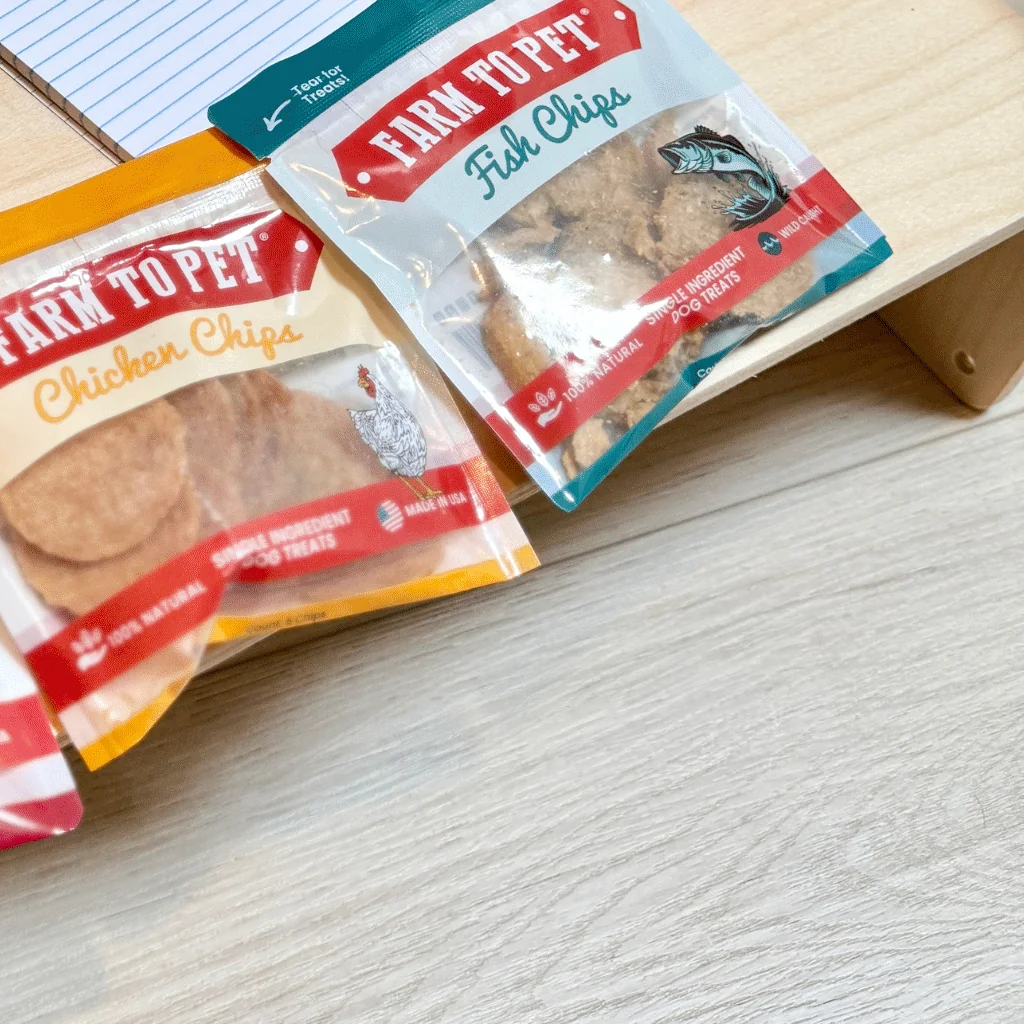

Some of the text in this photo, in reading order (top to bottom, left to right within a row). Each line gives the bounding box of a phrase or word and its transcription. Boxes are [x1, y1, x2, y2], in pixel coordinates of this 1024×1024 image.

[290, 65, 342, 95] Tear for
[301, 73, 350, 104] Treats!
[368, 81, 485, 169] FARM
[461, 50, 531, 97] TO
[464, 87, 632, 201] Fish Chips
[778, 220, 801, 239] WILD
[108, 256, 176, 310] TO
[645, 245, 746, 325] SINGLE INGREDIENT
[671, 270, 741, 325] DOG TREATS
[34, 313, 304, 423] Chicken Chips
[562, 337, 644, 403] 100% NATURAL
[268, 508, 352, 544] INGREDIENT
[405, 492, 467, 516] MADE IN USA
[282, 532, 337, 562] TREATS
[140, 580, 208, 626] NATURAL
